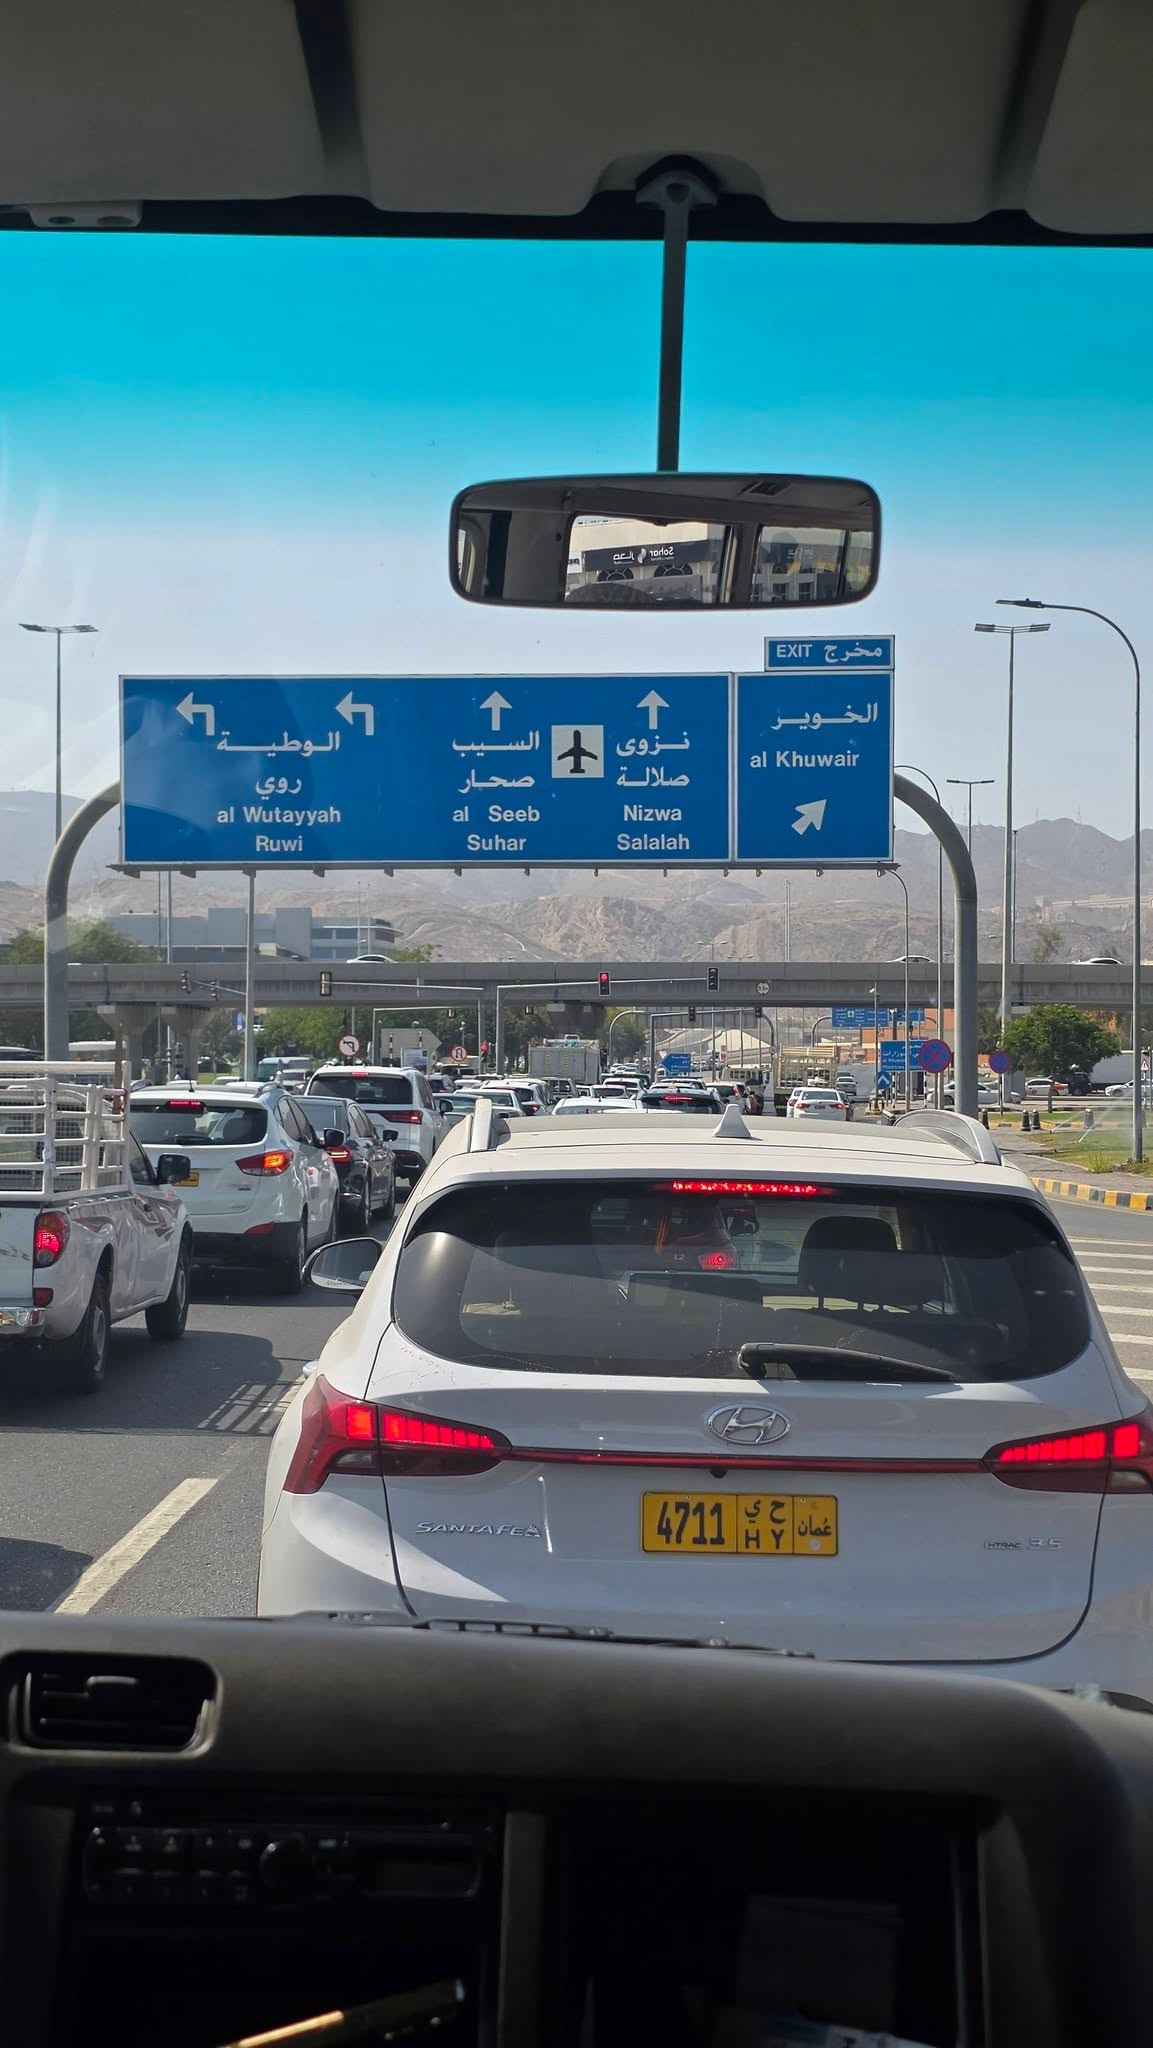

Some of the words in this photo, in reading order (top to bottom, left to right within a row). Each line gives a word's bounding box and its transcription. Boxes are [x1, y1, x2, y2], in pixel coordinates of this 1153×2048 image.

[776, 644, 813, 658] EXIT
[823, 644, 883, 663] مخرج
[770, 702, 879, 730] الخوير
[216, 730, 340, 757] الوطية
[452, 730, 540, 757] السيب
[616, 731, 690, 756] نزوى
[749, 750, 767, 768] al
[776, 750, 860, 767] Khuwair
[458, 769, 535, 793] صحار
[616, 766, 690, 787] صلالة
[255, 776, 302, 800] روي
[216, 806, 235, 823] al
[243, 806, 341, 827] Wutayyah
[452, 805, 469, 822] al
[487, 804, 541, 822] Seeb
[623, 804, 682, 821] Nizwa
[255, 834, 303, 852] Ruwi
[466, 833, 527, 851] Suhar
[616, 833, 690, 851] Salalah
[656, 1501, 726, 1545] 4711
[744, 1528, 761, 1550] H
[770, 1528, 785, 1550] Y
